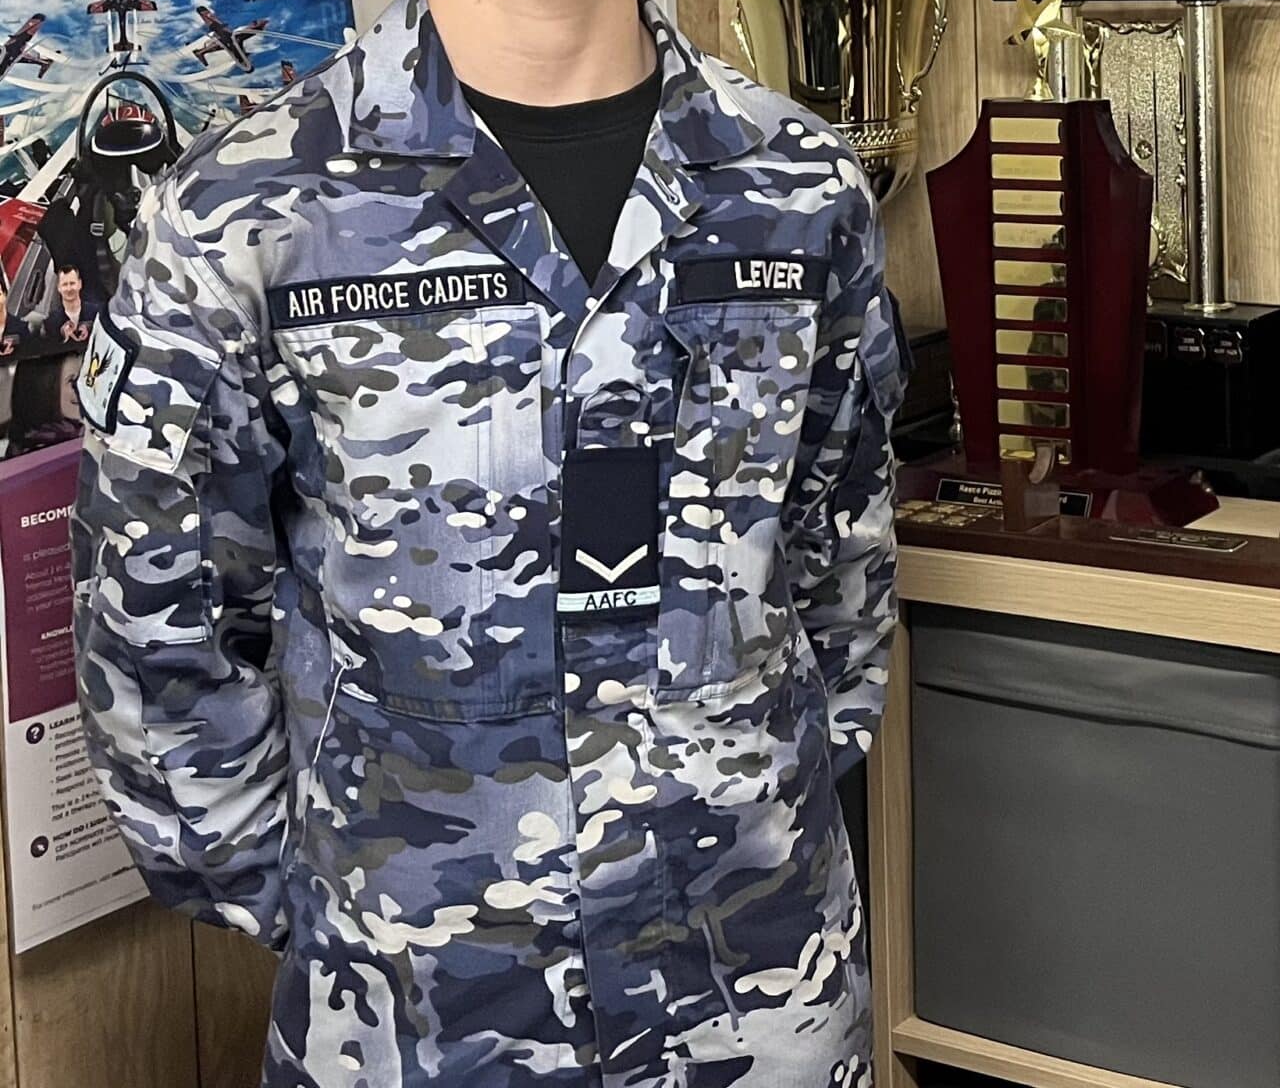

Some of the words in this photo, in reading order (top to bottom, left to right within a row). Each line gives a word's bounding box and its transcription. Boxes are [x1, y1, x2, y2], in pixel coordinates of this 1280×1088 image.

[734, 260, 805, 291] LEVER
[288, 287, 326, 318] AIR
[330, 281, 410, 314] FORCE
[418, 272, 508, 306] CADETS
[583, 590, 637, 611] AAFC
